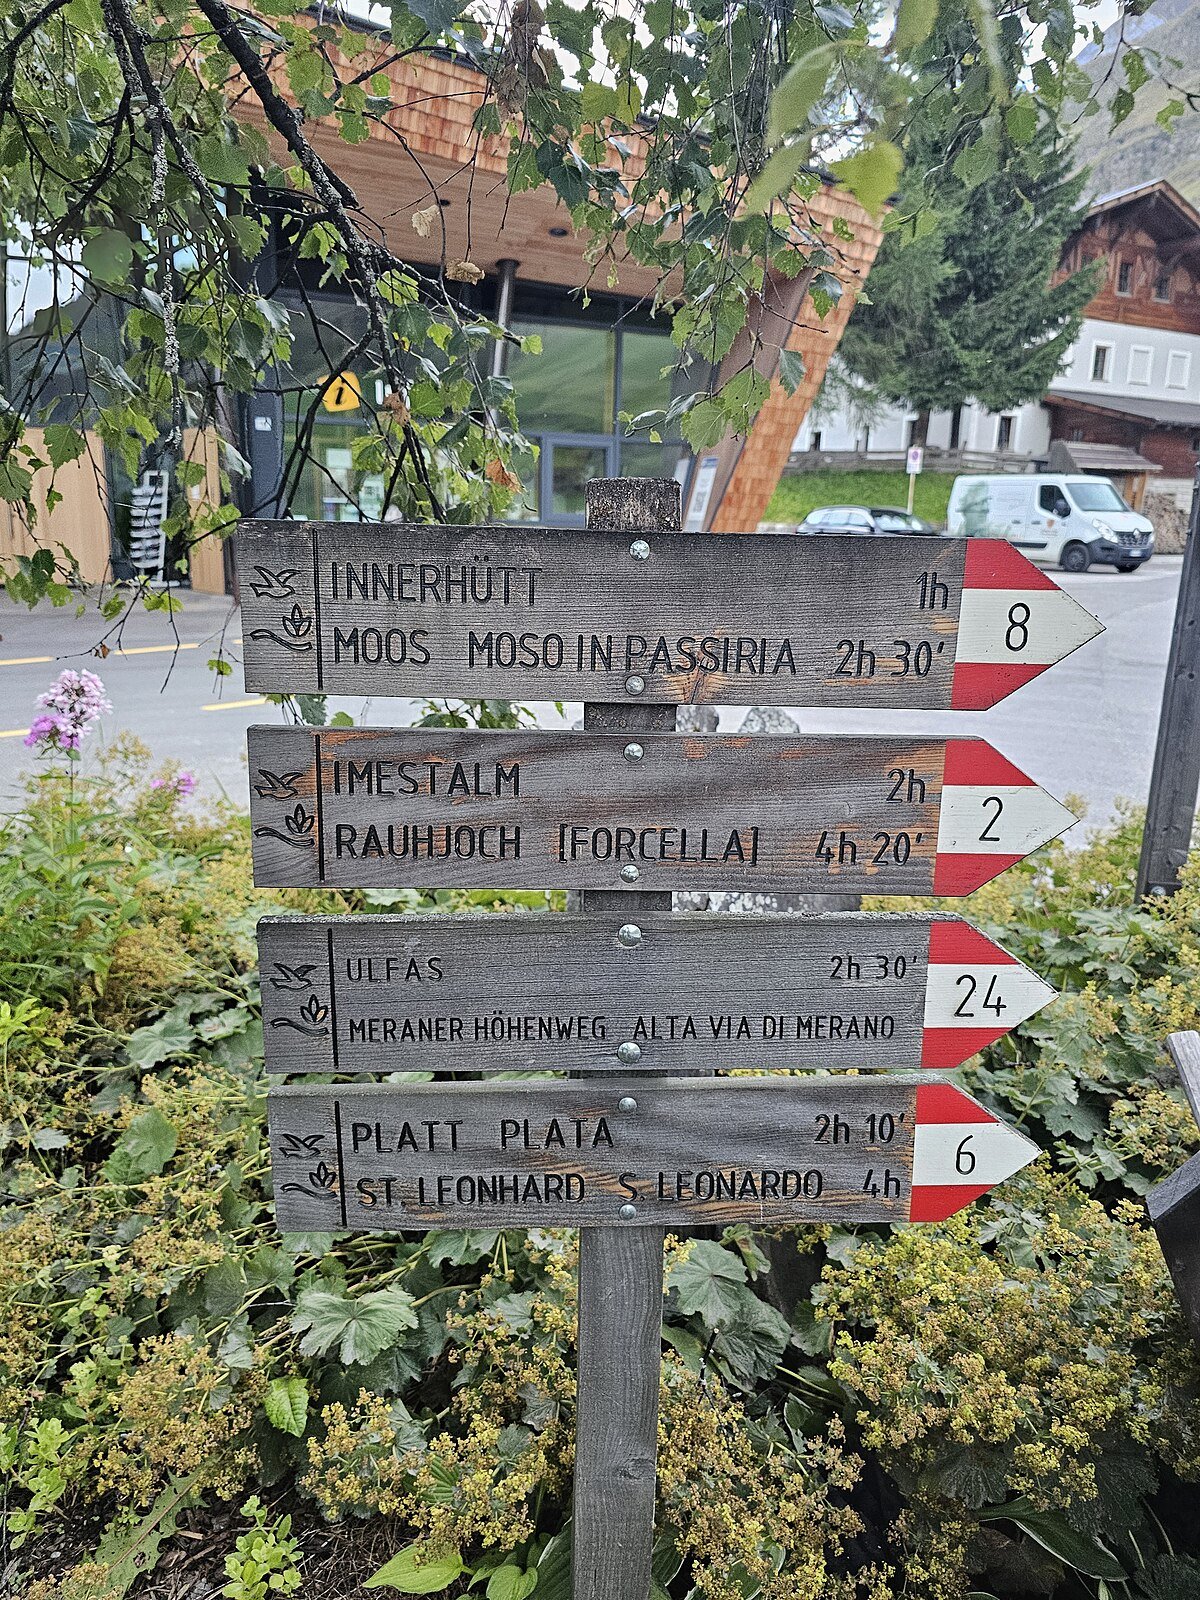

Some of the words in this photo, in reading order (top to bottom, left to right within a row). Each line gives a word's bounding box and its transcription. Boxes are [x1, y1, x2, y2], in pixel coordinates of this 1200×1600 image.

[331, 555, 543, 606] INNERHÜTT
[915, 571, 949, 610] 1h
[1004, 602, 1031, 652] 8
[333, 627, 431, 665] MOOS
[468, 631, 565, 670] MOSO
[577, 634, 613, 672] IN
[624, 635, 797, 676] PASSIRIA
[834, 640, 876, 677] 2h
[333, 761, 520, 797] IMESTALM
[886, 768, 926, 804] 2h
[978, 796, 1004, 842] 2
[336, 823, 522, 860] RAUHJOCH
[558, 823, 760, 867] [FORCELLA]
[814, 831, 858, 866] 4h
[346, 957, 444, 984] ULFAS
[829, 955, 861, 981] 2h
[953, 974, 1008, 1019] 24
[349, 1017, 464, 1044] MERANER
[474, 1010, 607, 1042] HÖHENWEG
[633, 1016, 698, 1041] ALTA
[710, 1016, 751, 1041] VIA
[762, 1016, 787, 1040] DI
[795, 1015, 895, 1040] MERANO
[351, 1119, 464, 1154] PLATT
[499, 1116, 616, 1150] PLATA
[813, 1113, 851, 1146] 2h
[955, 1135, 977, 1176] 6
[356, 1175, 407, 1208] ST.
[418, 1171, 586, 1207] LEONHARD
[656, 1168, 824, 1201] LEONARDO
[862, 1168, 901, 1199] 4h
